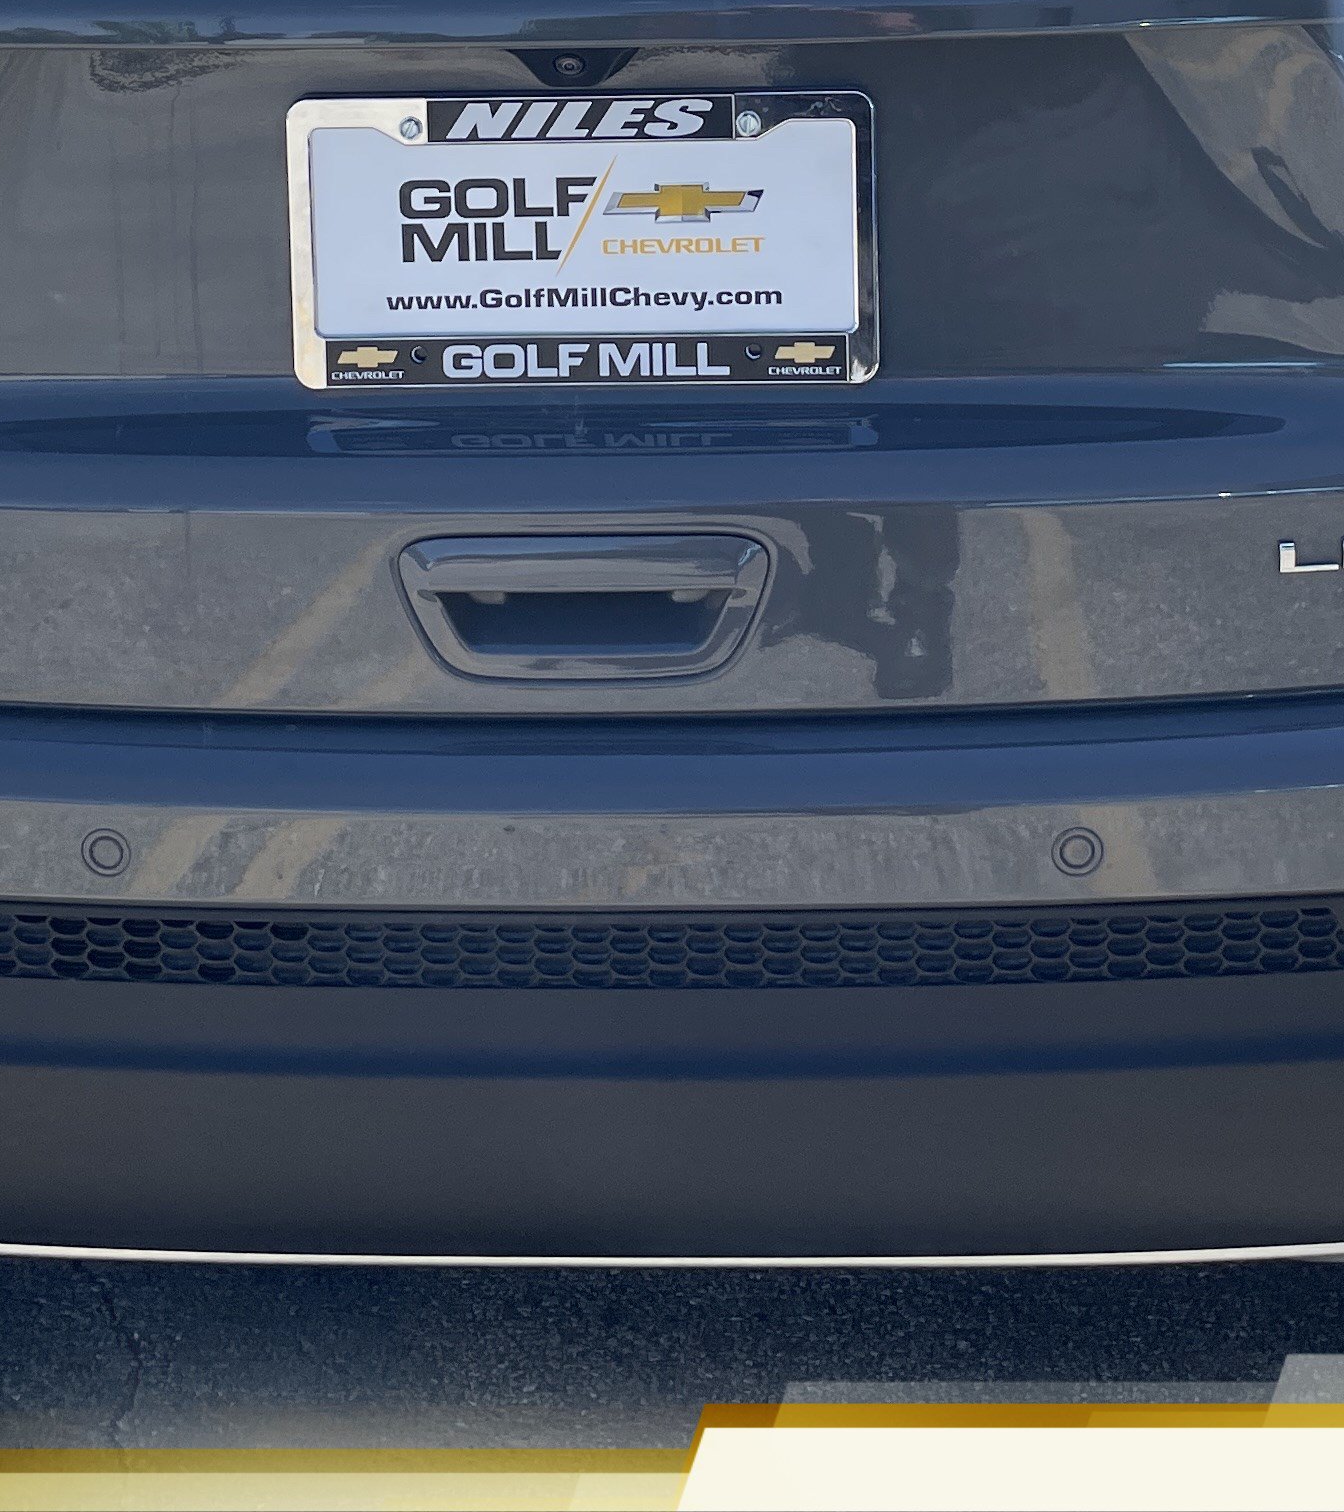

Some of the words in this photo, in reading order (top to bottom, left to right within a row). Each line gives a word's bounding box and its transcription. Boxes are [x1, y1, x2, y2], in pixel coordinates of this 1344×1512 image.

[446, 99, 714, 140] NILES
[398, 176, 598, 219] GOLF
[401, 221, 563, 264] MILL
[601, 235, 766, 256] CHEVROLET
[386, 286, 784, 313] www.GolfMillChevy.com
[330, 369, 405, 381] CHEVROLET
[442, 343, 591, 379] GOLF
[598, 341, 731, 378] MILL
[767, 365, 843, 377] CHEVROLET
